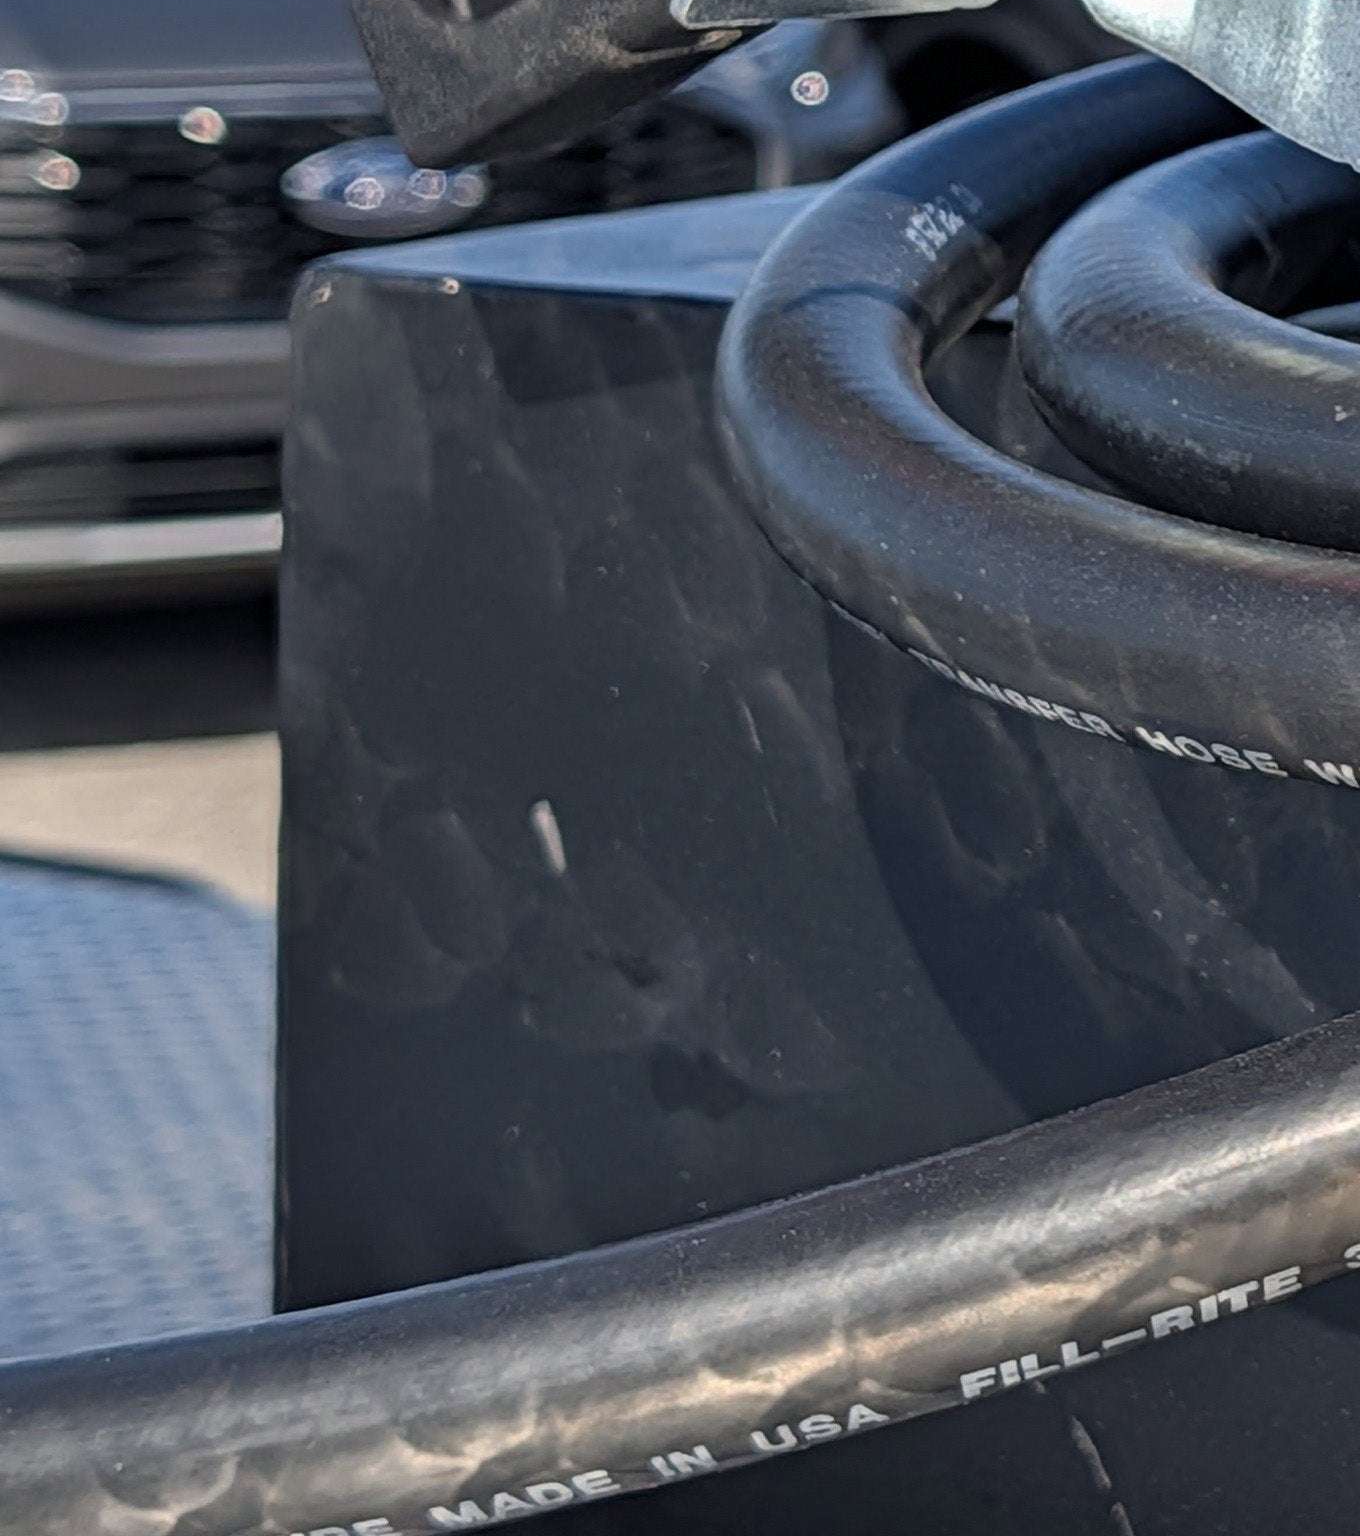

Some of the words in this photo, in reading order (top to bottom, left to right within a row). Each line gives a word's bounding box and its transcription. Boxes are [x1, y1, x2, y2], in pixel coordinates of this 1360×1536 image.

[1134, 725, 1288, 778] HOSE
[427, 1468, 622, 1531] MADE
[649, 1445, 717, 1478] IN
[750, 1402, 889, 1453] USA
[960, 1265, 1303, 1402] FILL-RITE
